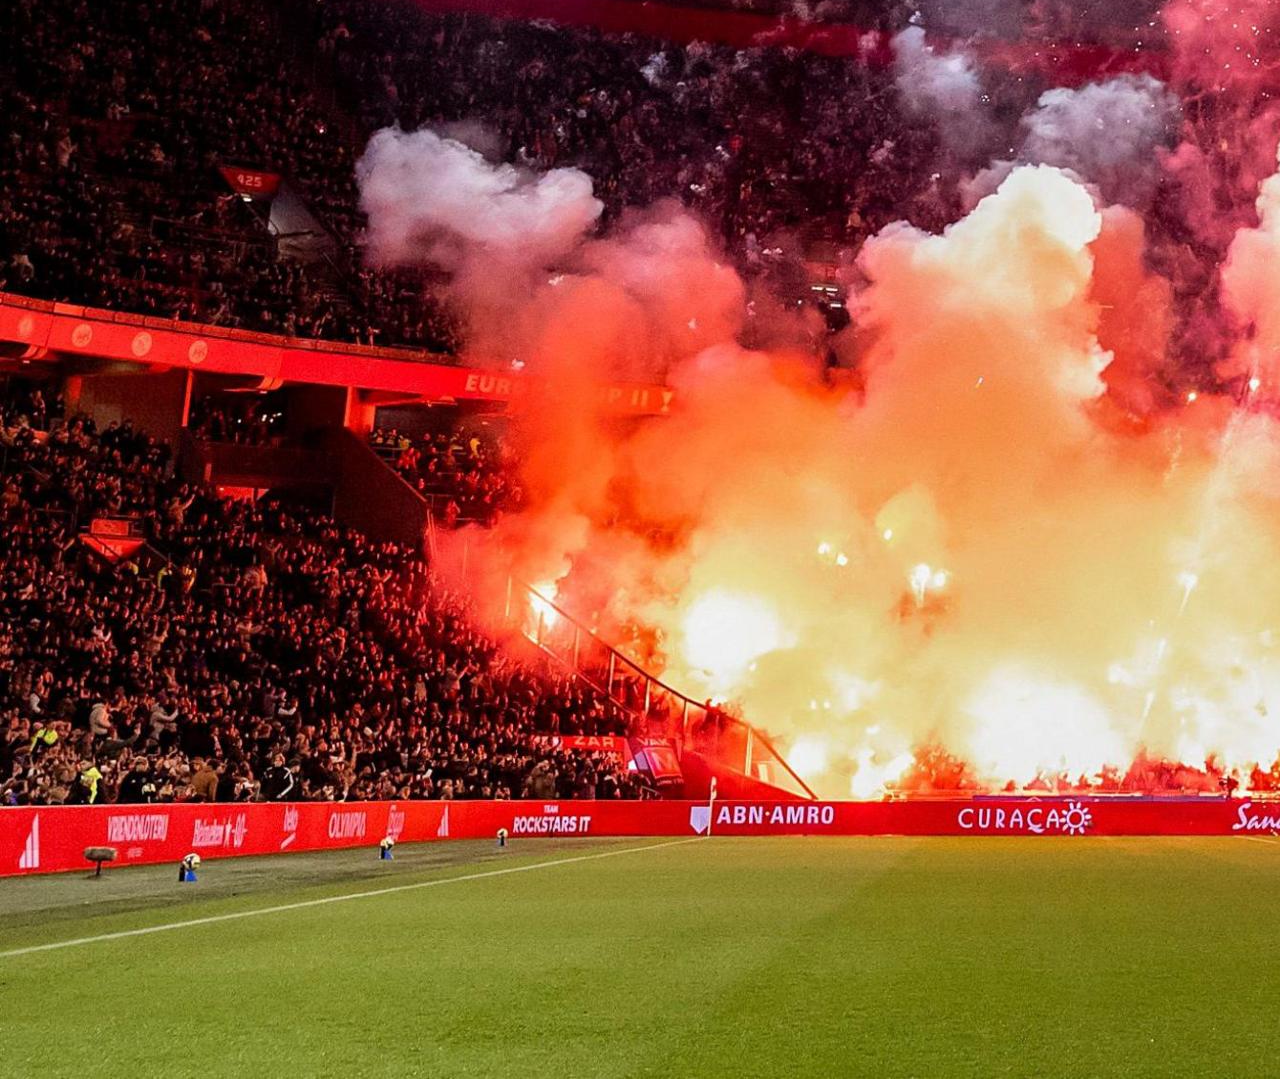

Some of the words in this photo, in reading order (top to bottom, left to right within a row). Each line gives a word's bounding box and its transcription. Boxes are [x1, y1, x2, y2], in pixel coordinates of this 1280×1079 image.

[237, 174, 263, 187] 425
[513, 816, 577, 833] ROCKSTARS
[578, 816, 591, 833] IT
